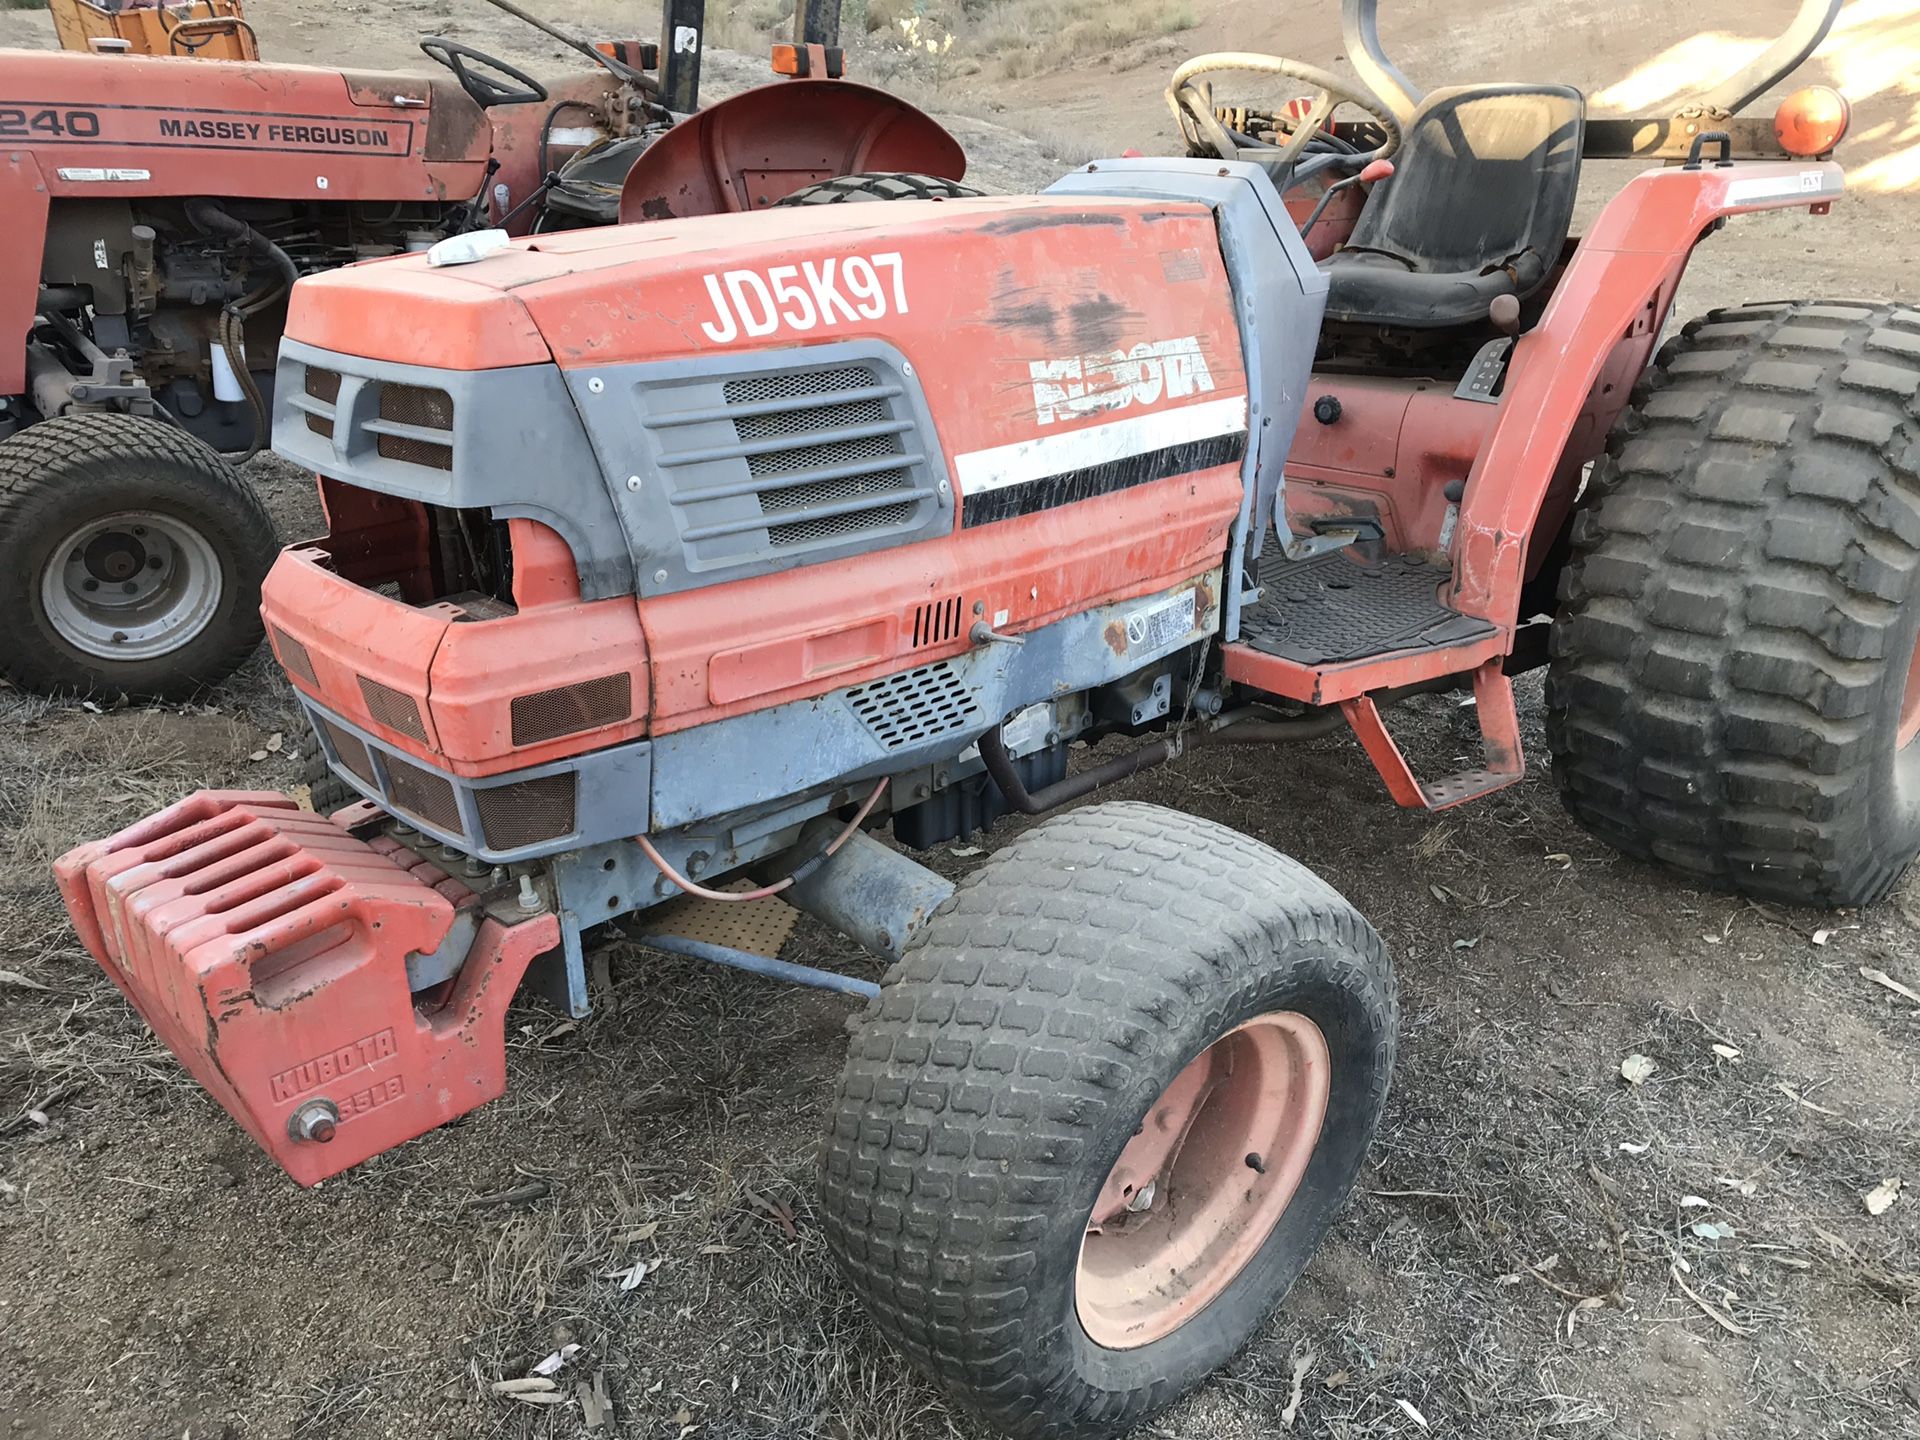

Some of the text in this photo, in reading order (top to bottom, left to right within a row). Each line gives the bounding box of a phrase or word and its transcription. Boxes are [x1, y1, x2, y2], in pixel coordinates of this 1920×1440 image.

[0, 109, 100, 137] 240
[159, 118, 389, 146] MASSEY FERGUSON
[701, 252, 910, 344] JD5K97
[272, 1029, 397, 1103] KUBOTA
